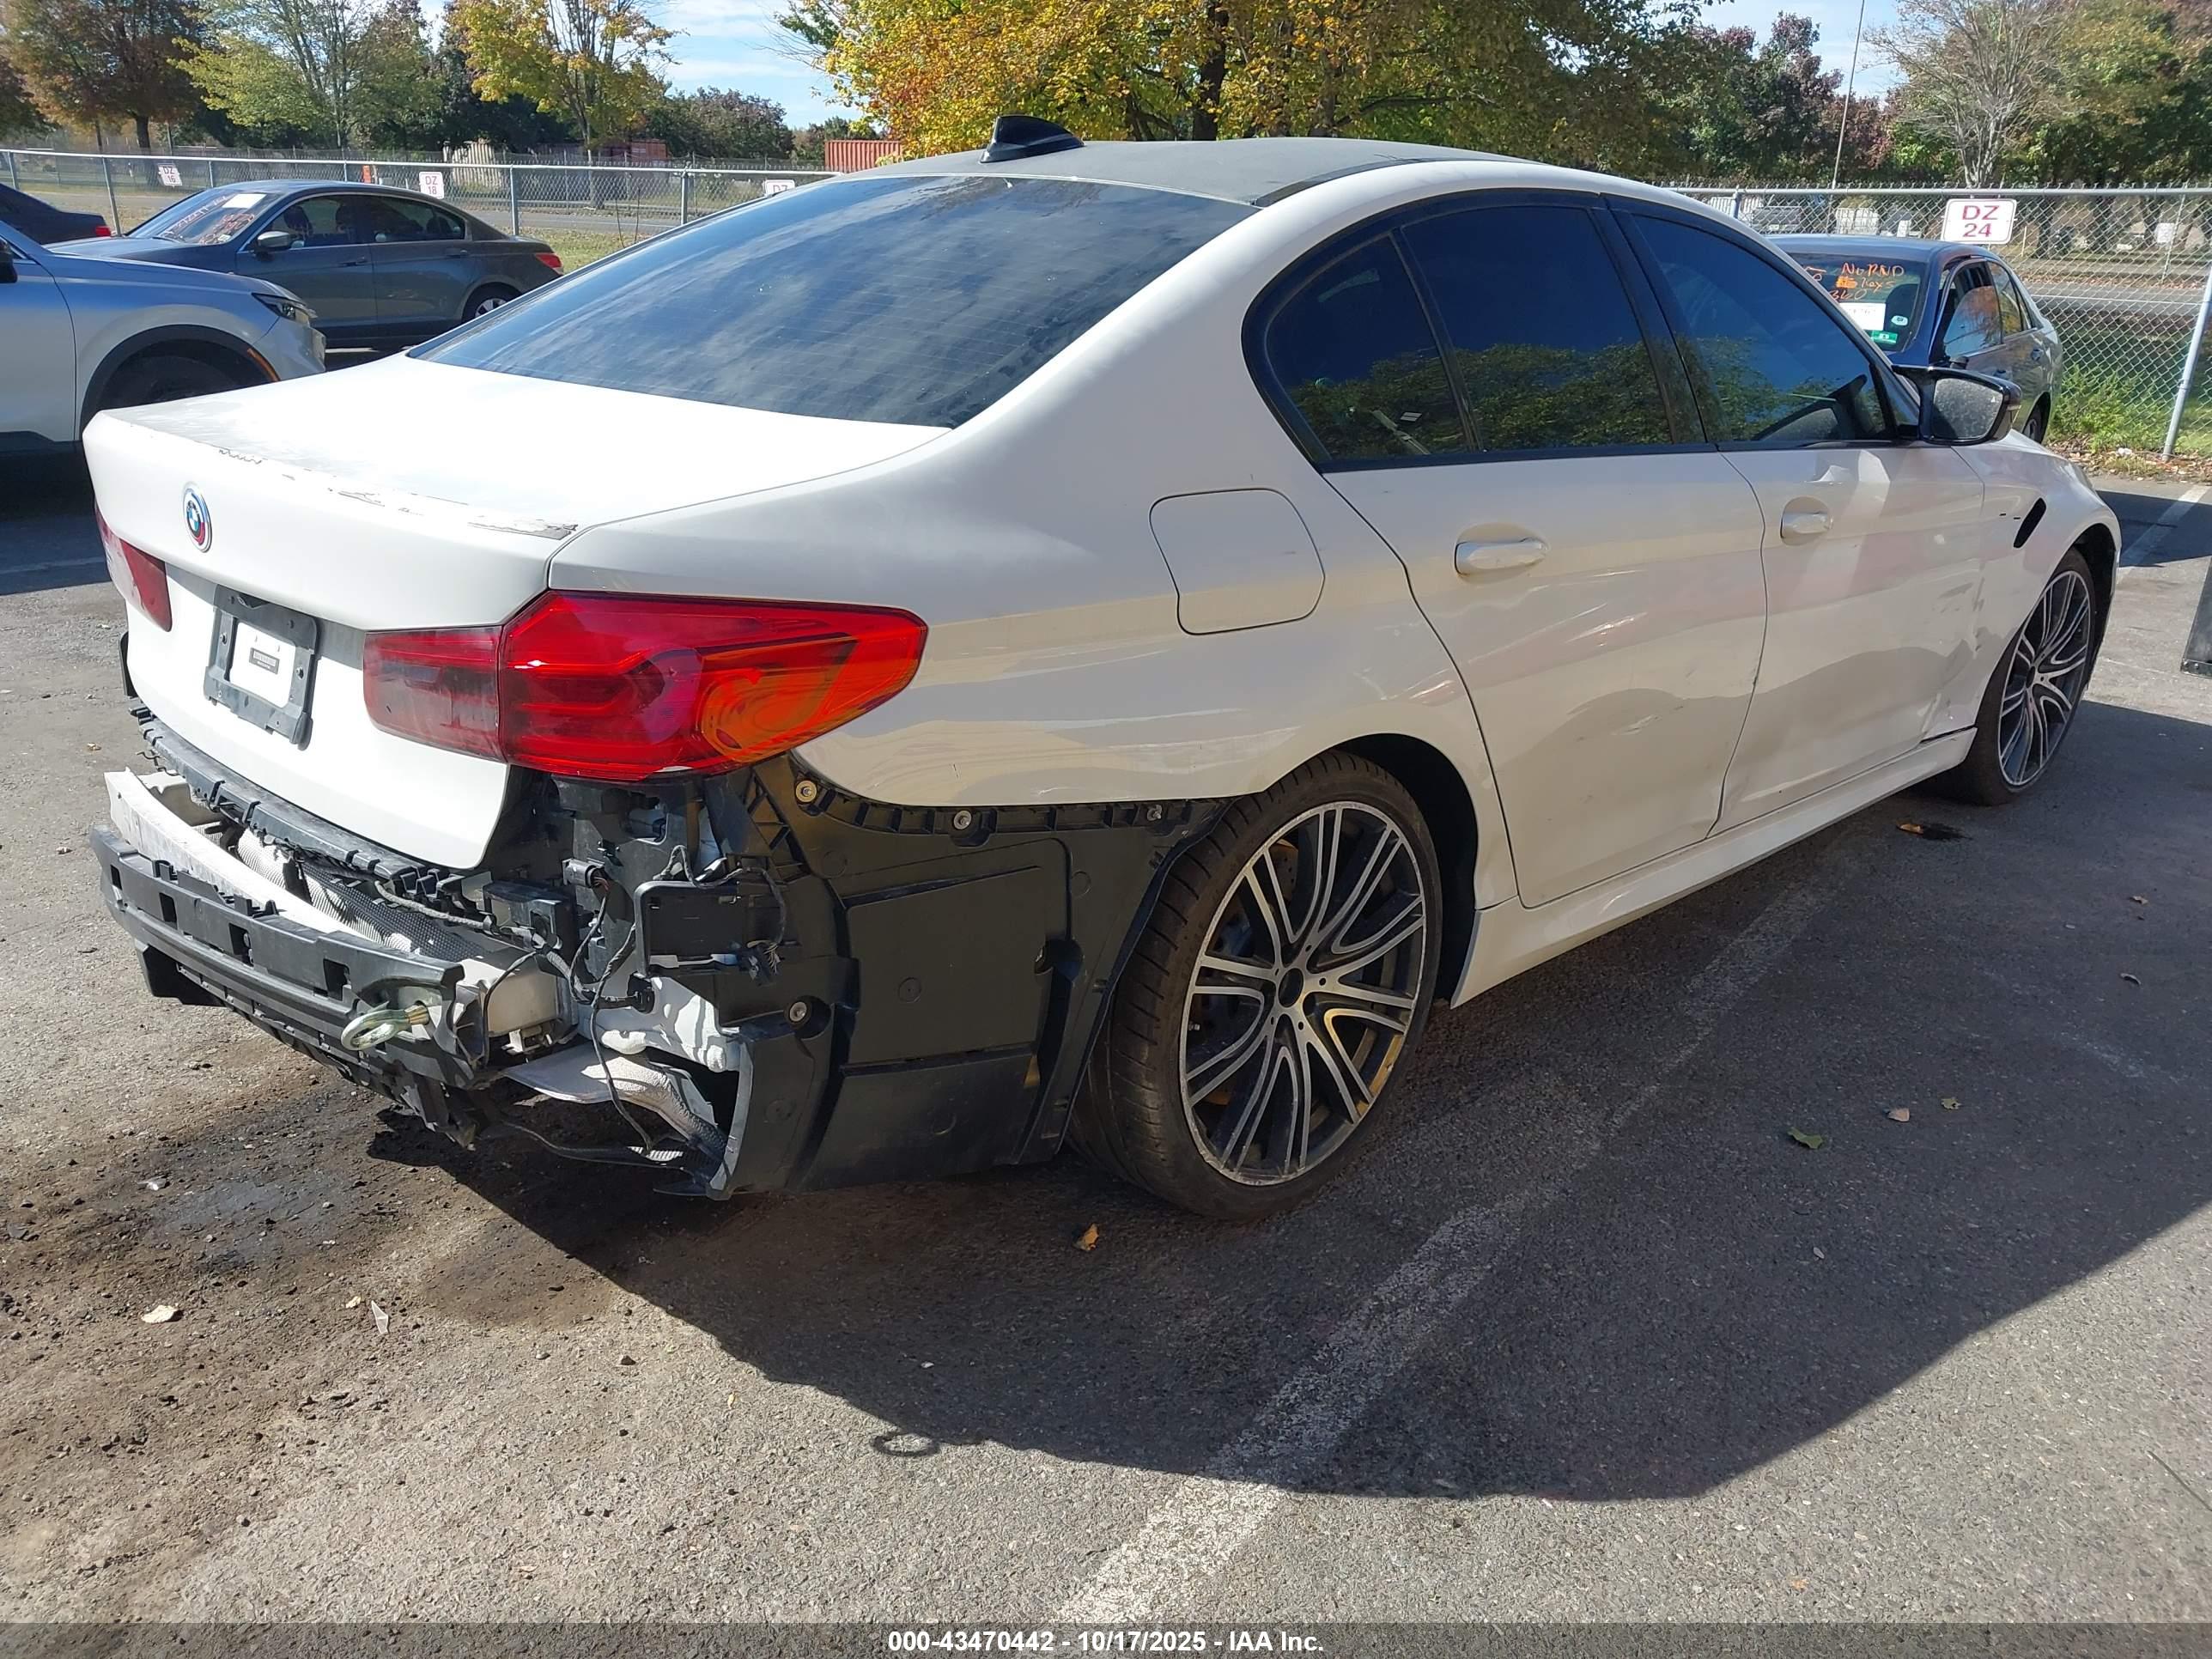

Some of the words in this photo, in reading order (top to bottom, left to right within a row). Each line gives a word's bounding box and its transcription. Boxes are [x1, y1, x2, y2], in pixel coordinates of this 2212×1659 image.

[425, 176, 439, 185] DZ
[428, 185, 438, 195] 18
[1961, 204, 2000, 221] DZ
[1962, 222, 1992, 238] 24
